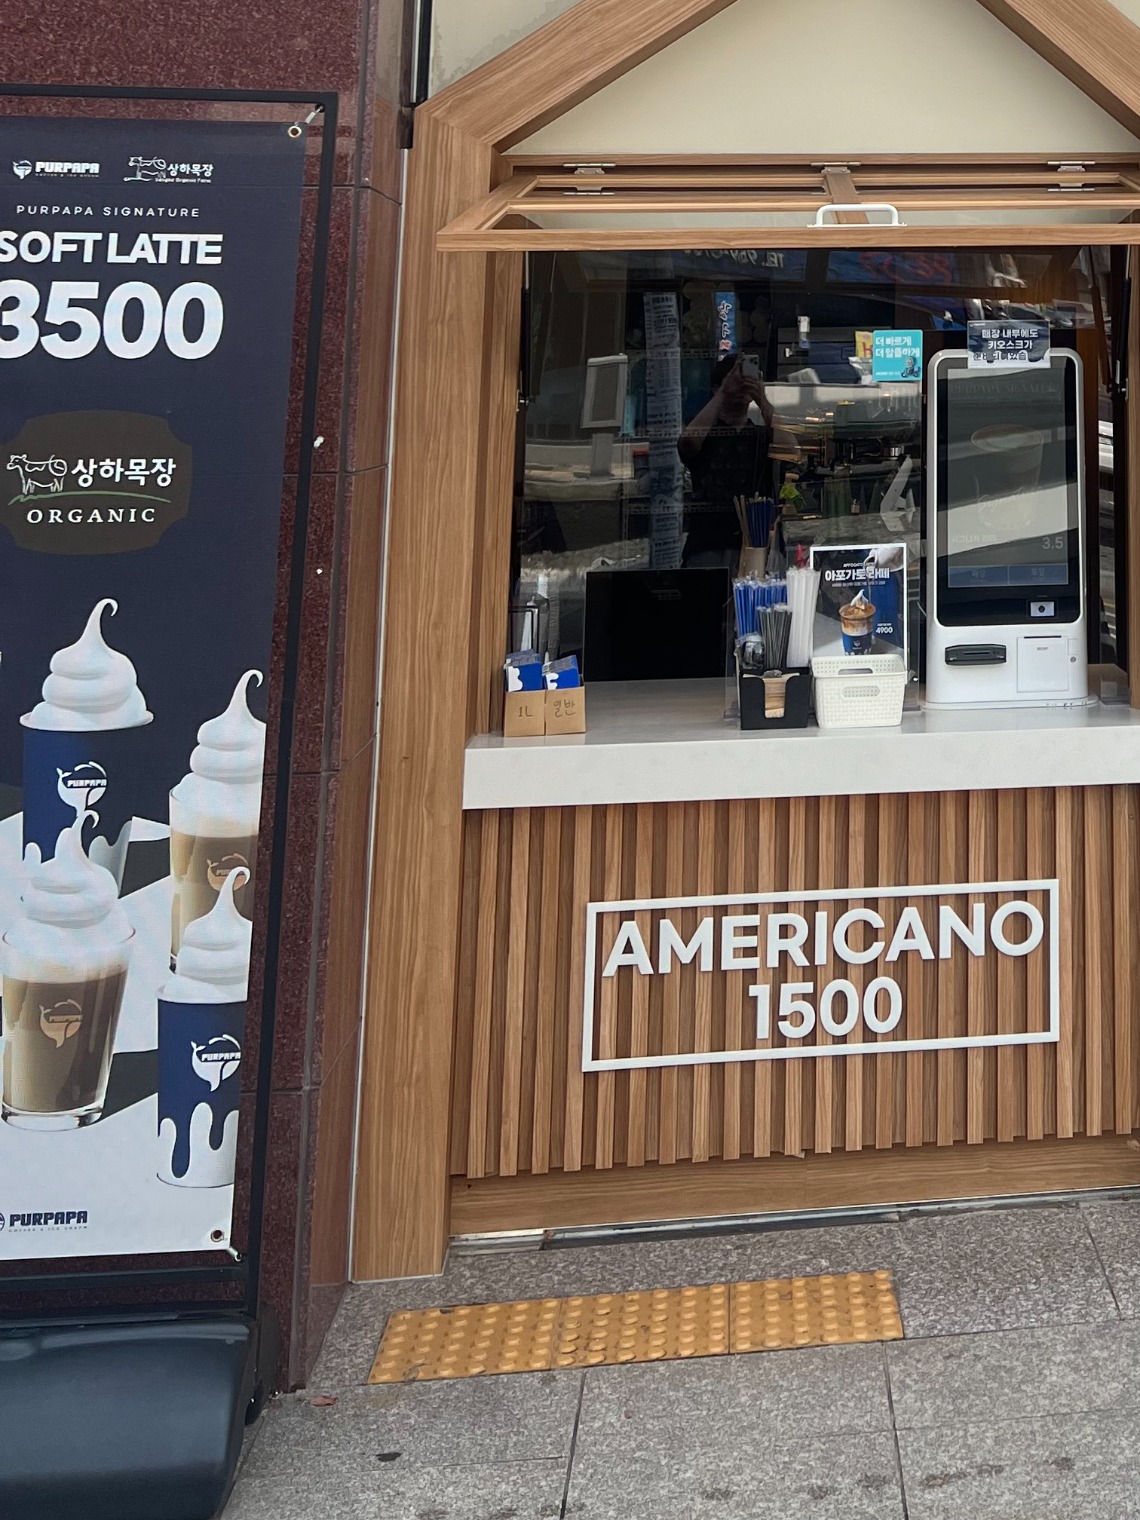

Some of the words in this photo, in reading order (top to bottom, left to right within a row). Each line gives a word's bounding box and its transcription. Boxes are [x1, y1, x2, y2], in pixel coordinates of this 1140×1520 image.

[35, 162, 99, 173] PURPAPA
[167, 163, 214, 177] 상하목장
[17, 205, 94, 216] PURPAPA
[103, 206, 199, 217] SIGNATURE
[0, 231, 103, 264] SOFT
[107, 233, 223, 265] LATTE
[0, 279, 224, 360] 3500
[988, 340, 1033, 350] 키오스크가
[71, 458, 176, 487] 상하목장
[27, 508, 155, 523] ORGANIC
[1042, 536, 1063, 550] 3.5
[553, 699, 577, 718] 일반
[602, 900, 1044, 977] AMERICANO
[749, 976, 902, 1040] 1500
[9, 1210, 88, 1227] PURPAPA
